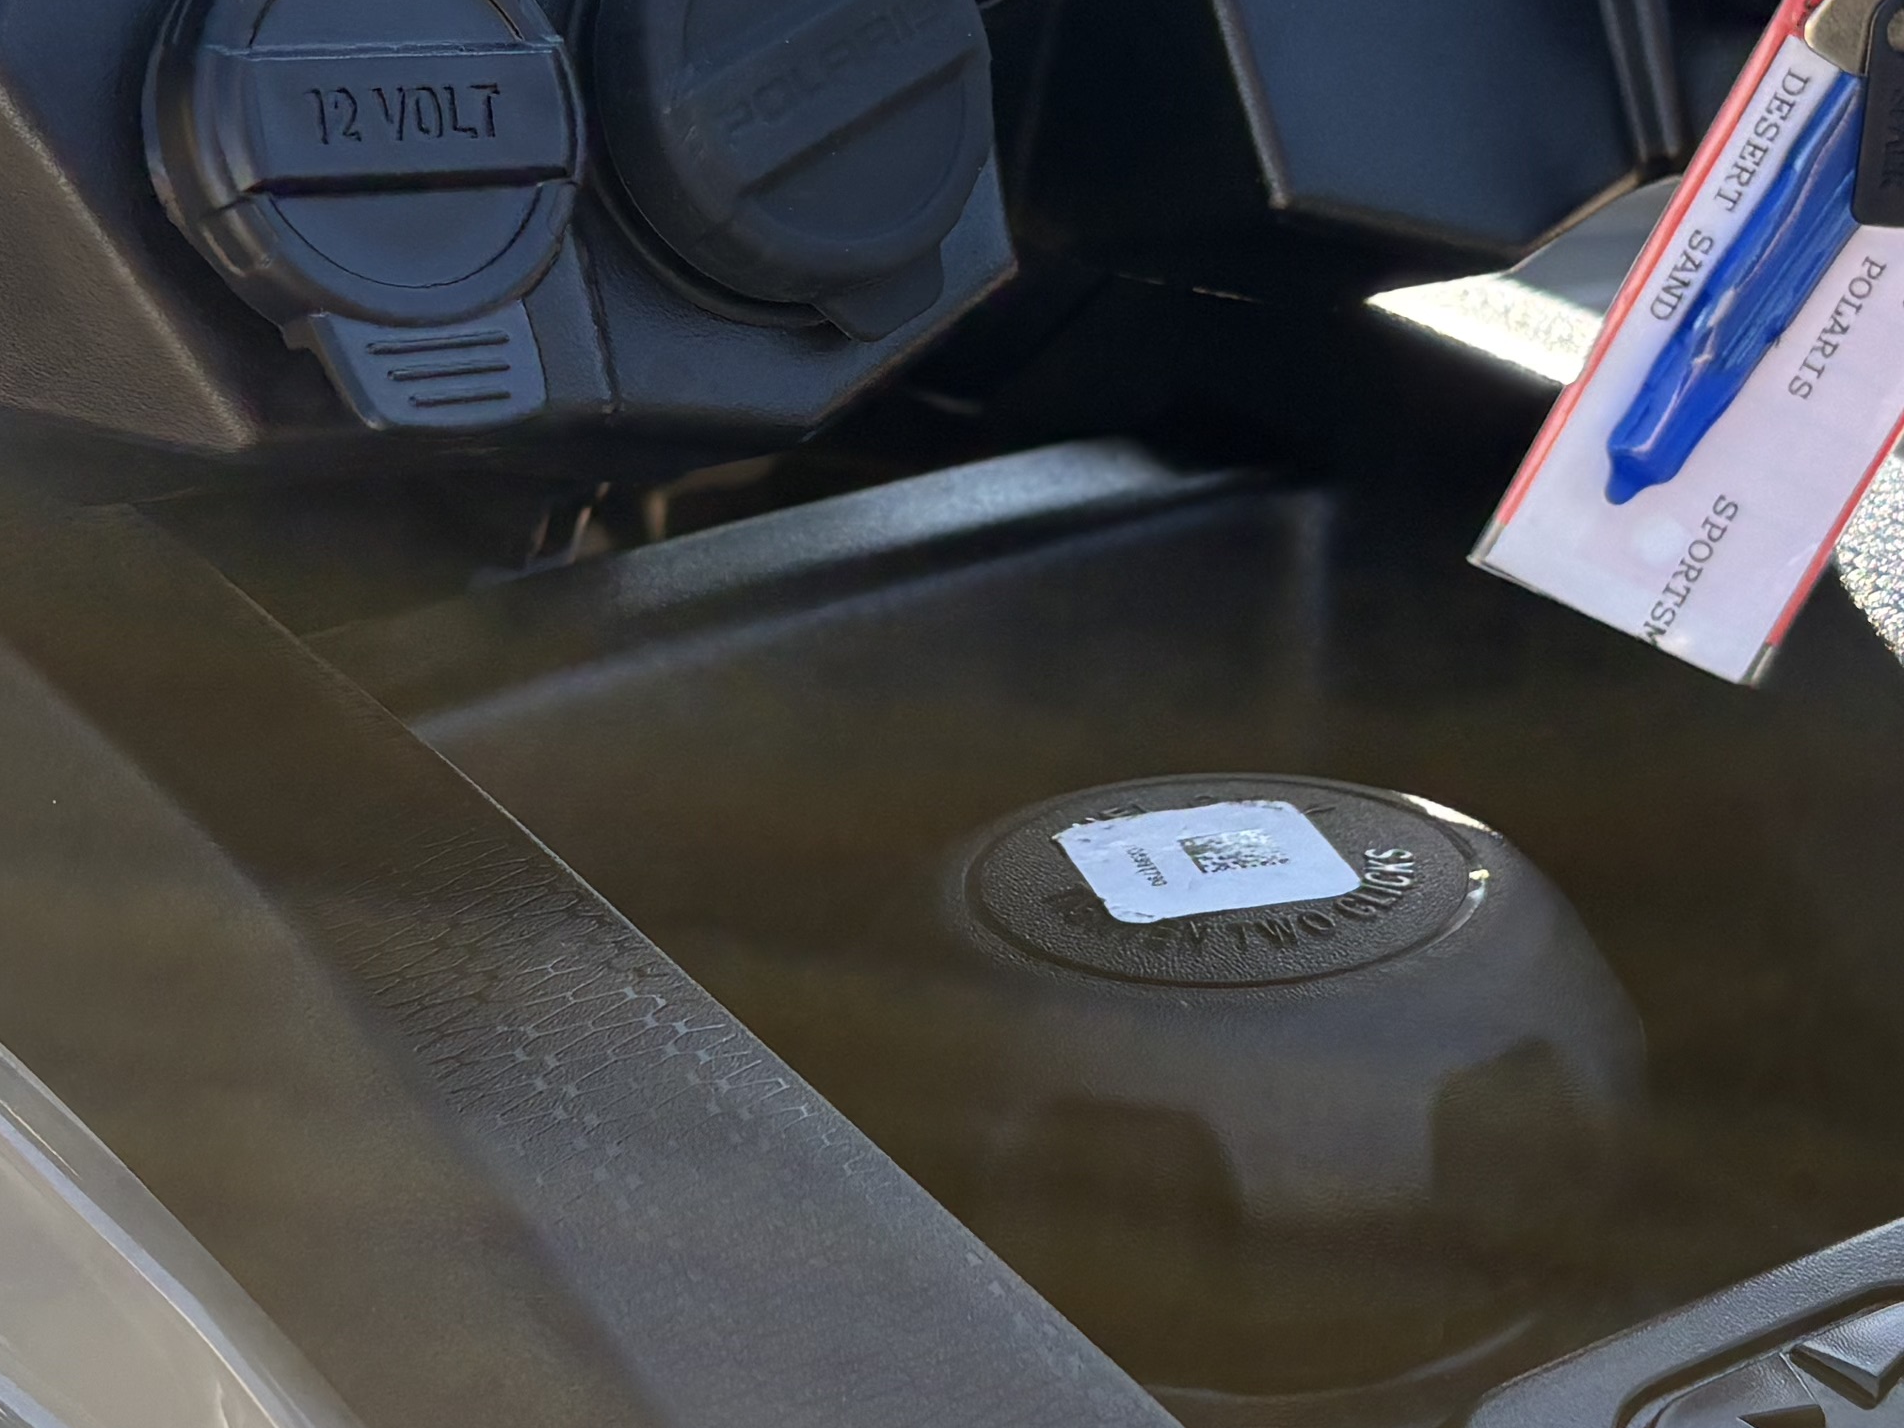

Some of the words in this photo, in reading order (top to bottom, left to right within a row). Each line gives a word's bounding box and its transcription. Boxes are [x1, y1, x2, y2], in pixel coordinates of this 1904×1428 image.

[303, 86, 363, 146] 12
[370, 82, 501, 142] VOLT
[1713, 66, 1811, 214] DESERT
[1648, 227, 1716, 323] SAND
[1787, 254, 1888, 401] POLARIS
[1335, 847, 1415, 918] CLICKS
